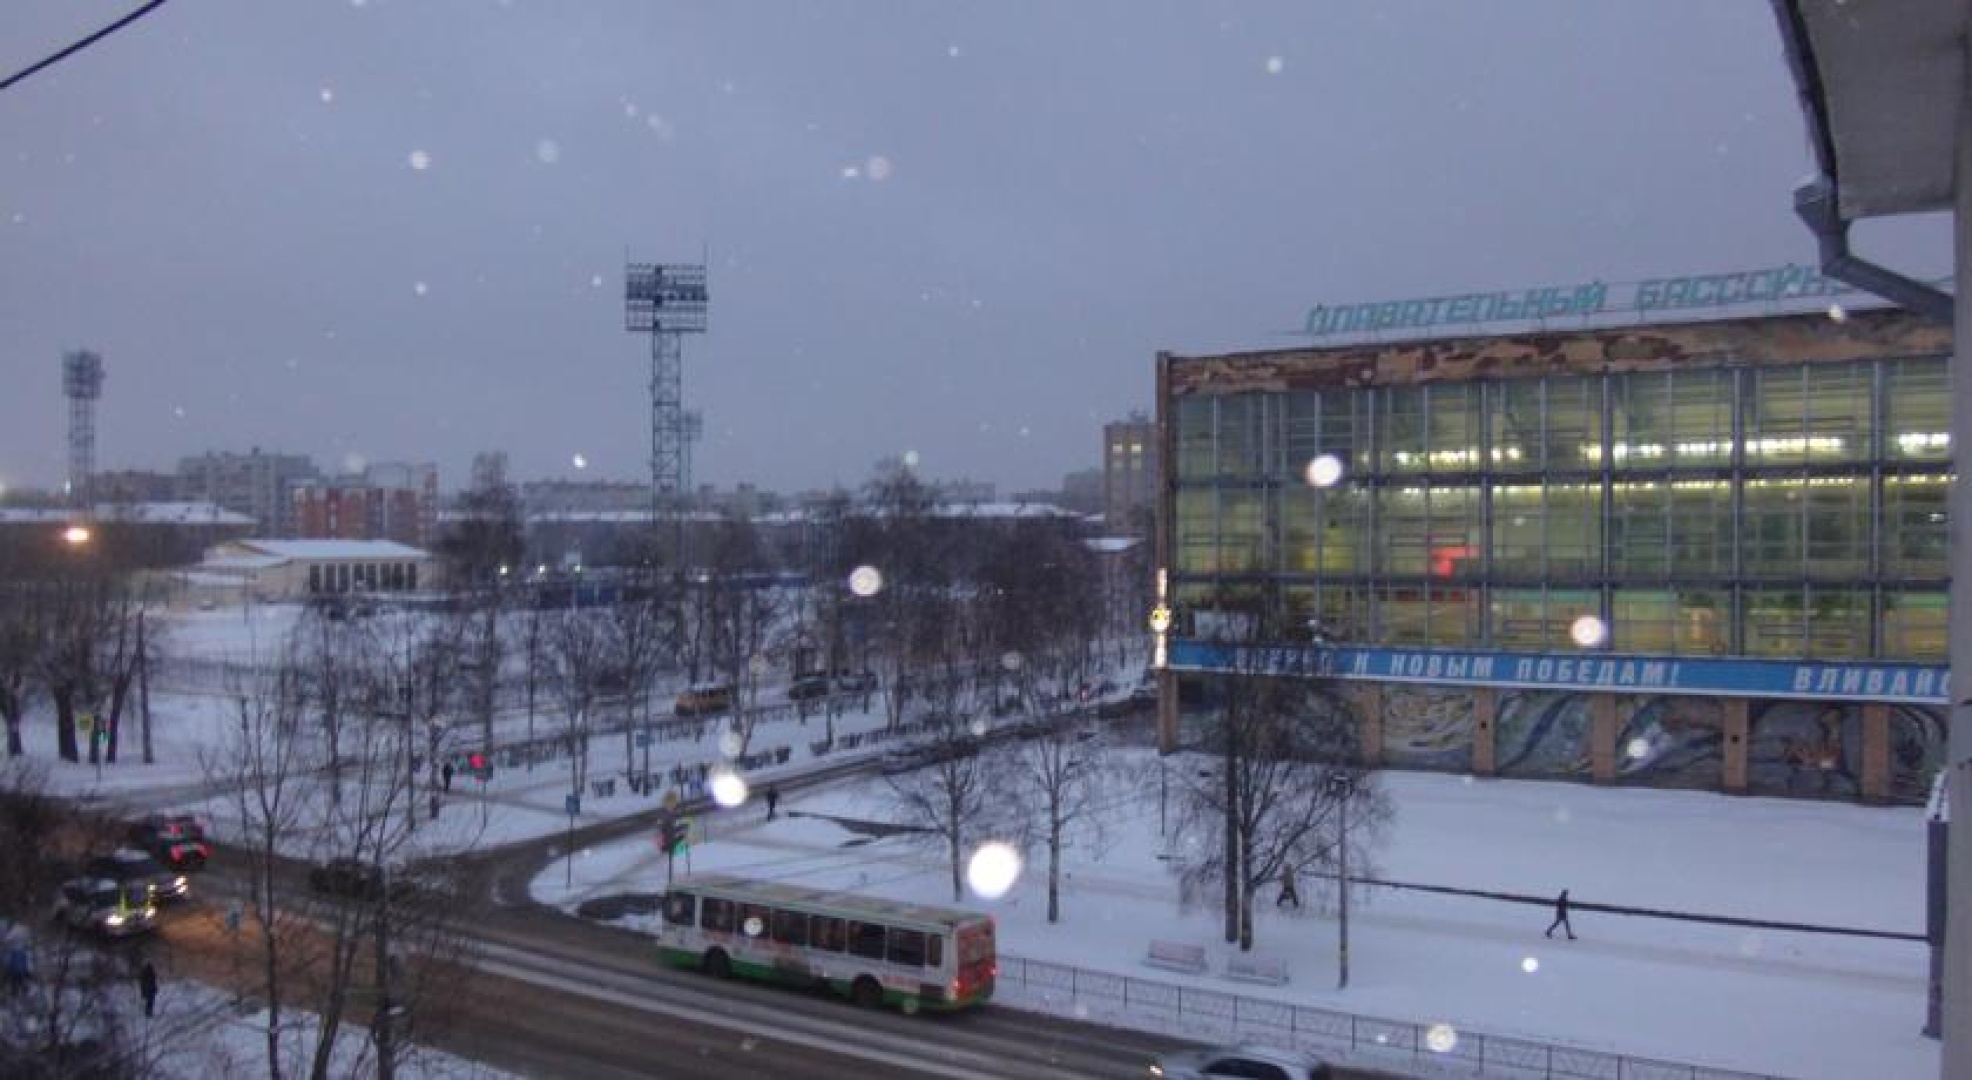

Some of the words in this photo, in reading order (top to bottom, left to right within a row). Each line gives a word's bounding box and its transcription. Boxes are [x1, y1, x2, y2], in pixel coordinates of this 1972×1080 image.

[1305, 279, 1608, 334] ПЛАВАТЕЛЬНЫЙ
[1388, 653, 1495, 678] НОВЫМ
[1516, 657, 1681, 687] ПОБЕДАМ!
